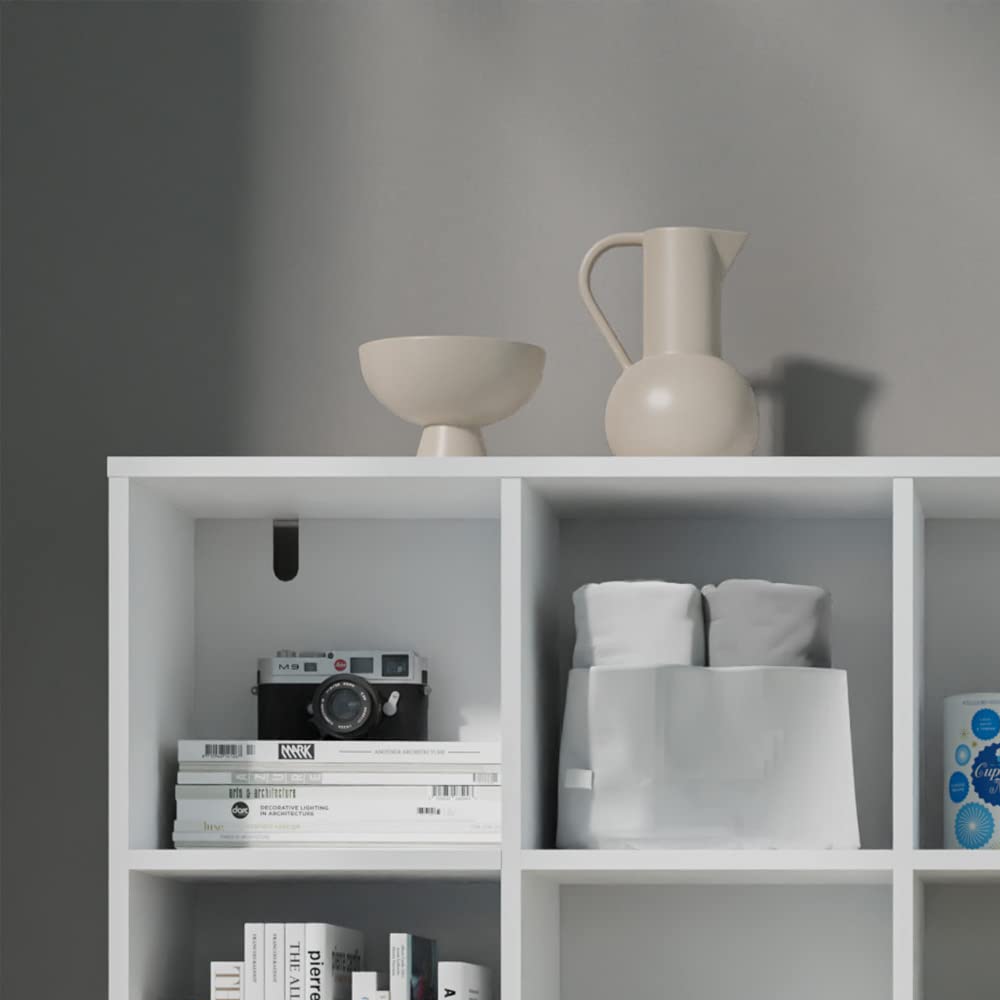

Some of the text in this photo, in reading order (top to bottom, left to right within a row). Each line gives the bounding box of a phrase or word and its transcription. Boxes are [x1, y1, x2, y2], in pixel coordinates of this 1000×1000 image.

[278, 663, 300, 671] M9
[280, 744, 312, 760] MARK
[229, 788, 243, 799] arts
[253, 788, 297, 799] architecture
[289, 941, 301, 972] THE
[444, 988, 456, 998] A
